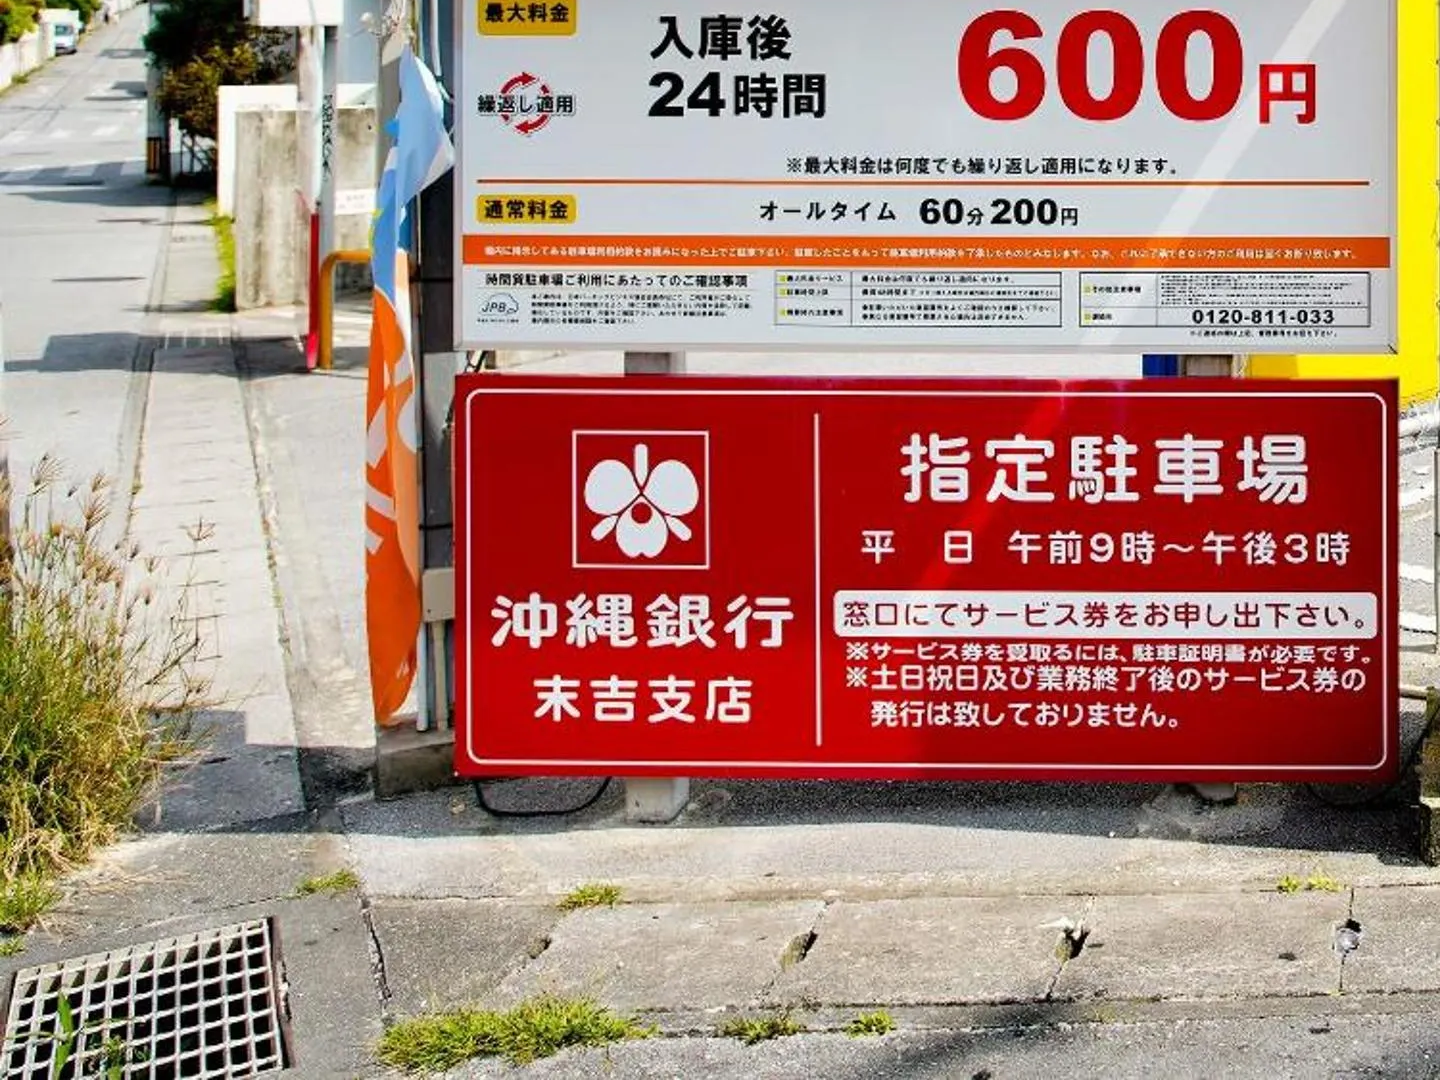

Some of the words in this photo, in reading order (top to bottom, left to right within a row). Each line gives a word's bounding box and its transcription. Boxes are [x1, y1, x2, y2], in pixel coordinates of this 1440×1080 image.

[485, 3, 569, 23] 最大料金
[650, 15, 792, 61] 入庫後
[477, 95, 574, 115] 繰返し適用
[648, 72, 826, 119] 24時間
[786, 157, 1178, 176] ※最大料金は何度でも繰り返し適用になります。
[484, 199, 569, 220] 通常料金
[1192, 309, 1335, 324] 0120-811-033
[900, 433, 1308, 504] 指定駐車場
[491, 592, 794, 649] 沖縄銀行
[842, 600, 1364, 629] 窓口にてサービス券をお申し出下さい。
[846, 642, 1370, 664] ※サービス券を受取るには、駐車証明書が必要です。
[846, 664, 1366, 693] ※土日祝日及び業務終了後のサービス券の
[533, 674, 753, 724] 末吉支店
[871, 700, 1178, 728] 発行は致しておりません。
